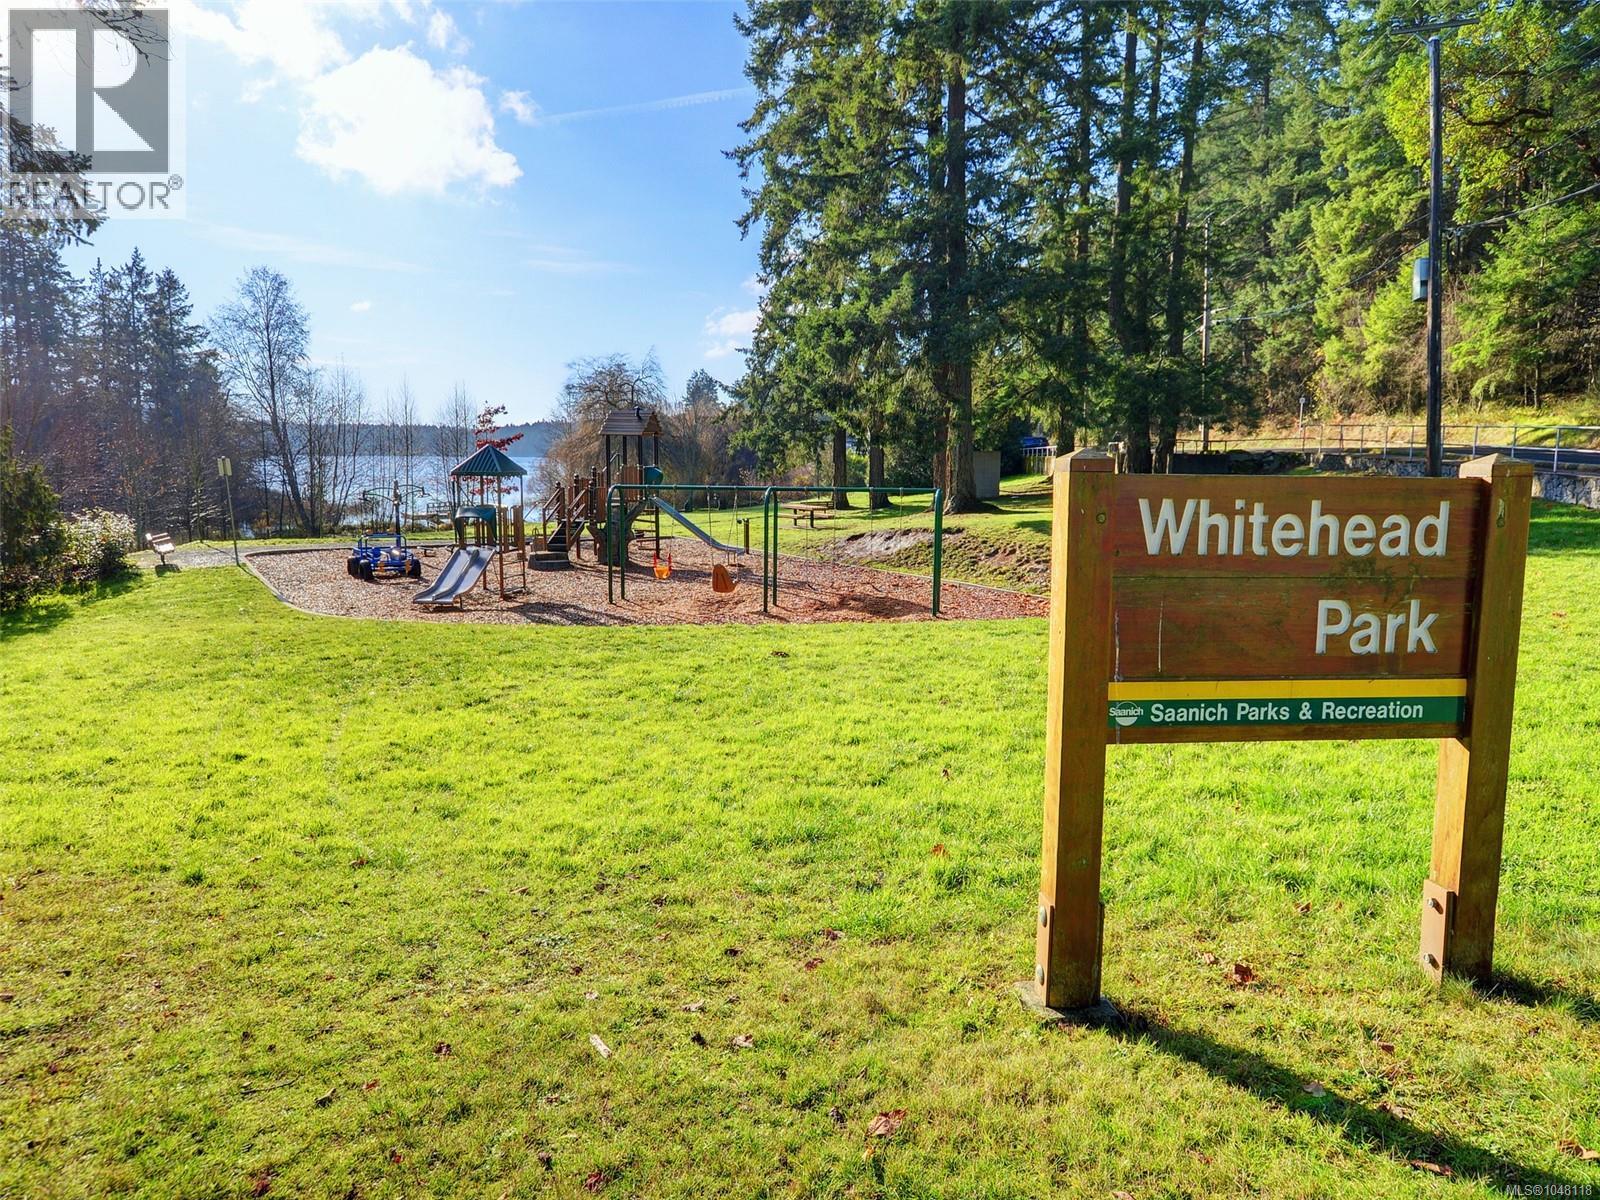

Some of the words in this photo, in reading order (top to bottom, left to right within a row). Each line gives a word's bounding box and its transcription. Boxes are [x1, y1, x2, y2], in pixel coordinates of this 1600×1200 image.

[1138, 498, 1450, 557] Whitehead
[1315, 599, 1438, 655] Park
[1109, 706, 1144, 717] Saanich
[1150, 703, 1228, 722] Saanich
[1236, 702, 1290, 721] Parks
[1299, 701, 1313, 720] &
[1321, 701, 1424, 720] Recreation
